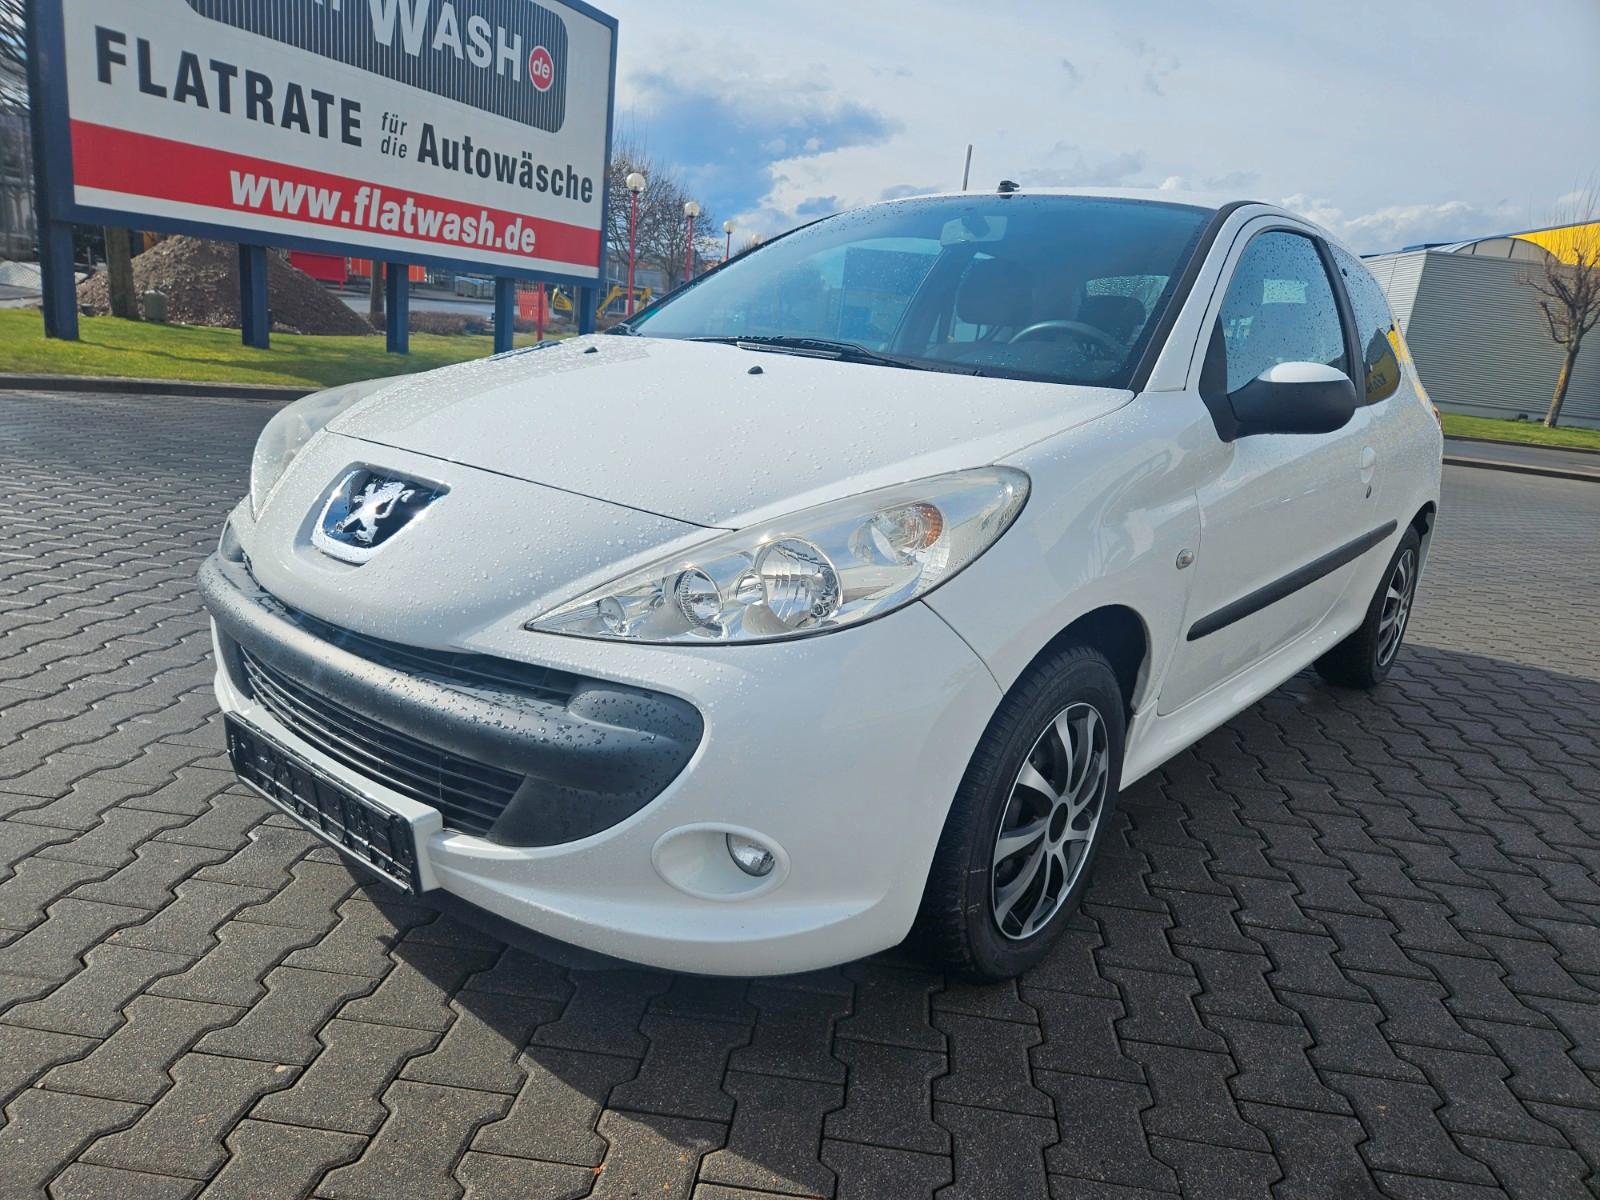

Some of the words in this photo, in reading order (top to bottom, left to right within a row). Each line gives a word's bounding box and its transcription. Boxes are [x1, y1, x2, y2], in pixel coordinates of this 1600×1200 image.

[95, 24, 362, 147] FLATRATE
[532, 56, 551, 79] de
[381, 112, 408, 136] für
[381, 135, 408, 159] die
[417, 122, 593, 204] Autowäsche
[229, 170, 536, 253] www.flatwash.de
